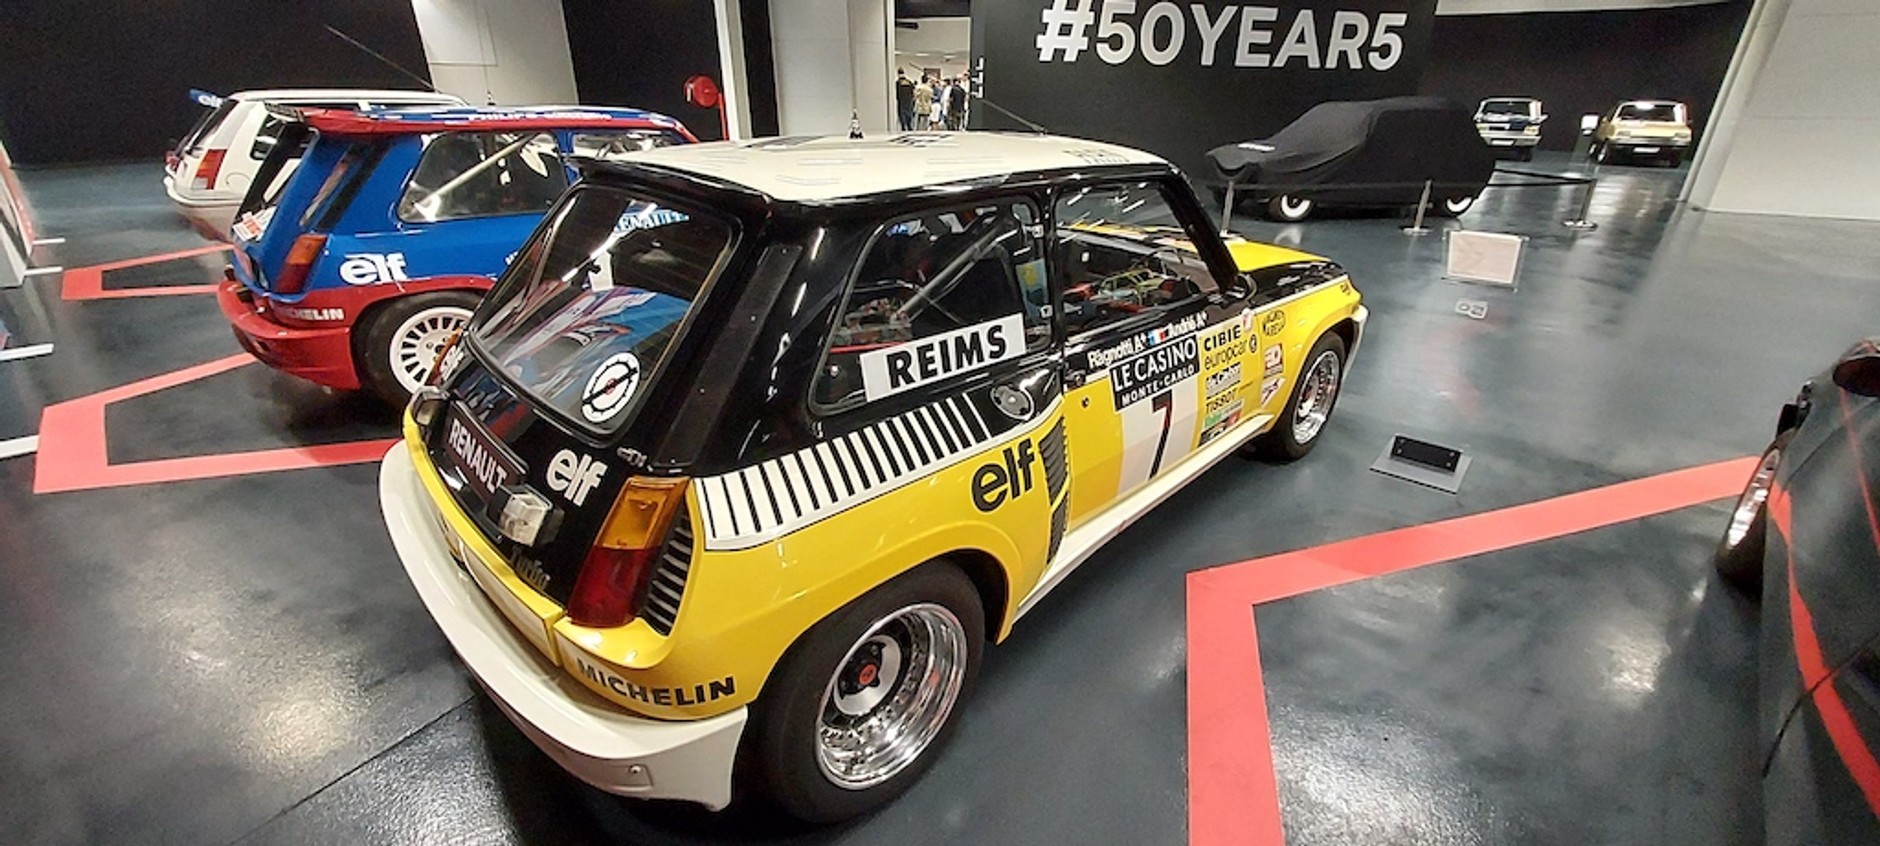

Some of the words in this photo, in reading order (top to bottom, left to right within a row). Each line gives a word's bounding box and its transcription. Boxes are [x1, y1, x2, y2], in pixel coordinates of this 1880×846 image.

[1036, 0, 1407, 71] #50YEAR5
[614, 209, 687, 234] ENAULT
[339, 252, 407, 286] elf
[275, 306, 345, 322] CHELIN
[1204, 324, 1241, 352] CIBIE
[887, 325, 1007, 390] REIMS
[1112, 364, 1133, 392] LE
[1134, 339, 1197, 381] CASINO
[1205, 339, 1248, 370] europcar
[449, 418, 508, 494] RENAULT
[1151, 388, 1174, 480] 7
[547, 448, 608, 507] elf
[971, 437, 1036, 513] elf
[576, 657, 736, 707] MICHELIN
